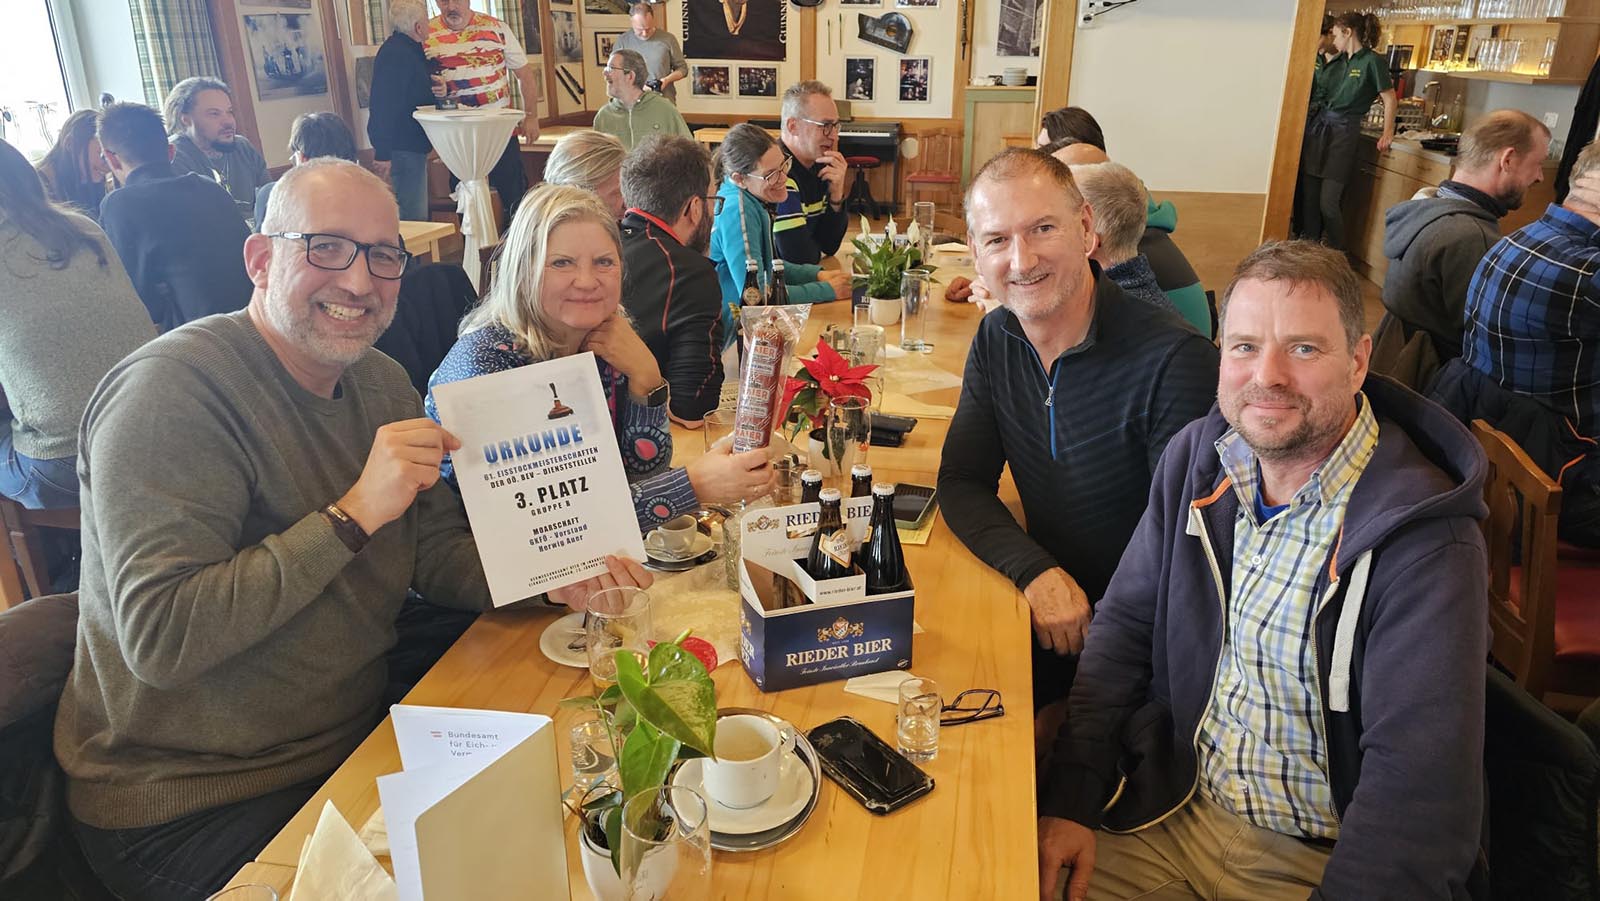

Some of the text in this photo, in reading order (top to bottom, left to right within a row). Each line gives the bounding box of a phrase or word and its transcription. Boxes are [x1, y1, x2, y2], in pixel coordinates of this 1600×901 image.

[484, 424, 583, 464] URKUNDE
[497, 446, 599, 478] EISSTOCKMEISTERSCHAFTEN
[490, 478, 505, 489] DER
[520, 471, 534, 481] BEV
[542, 456, 597, 475] DIENSTSTELLEN
[514, 476, 589, 509] 3. PLATZ
[530, 502, 562, 516] GRUPPE
[847, 505, 872, 519] BIE
[532, 517, 580, 535] MOARSCHAFT
[553, 523, 588, 539] Vorstand
[538, 534, 584, 552] Herwig Auer
[785, 638, 892, 667] RIEDER BIER
[447, 731, 499, 740] Bundesamt
